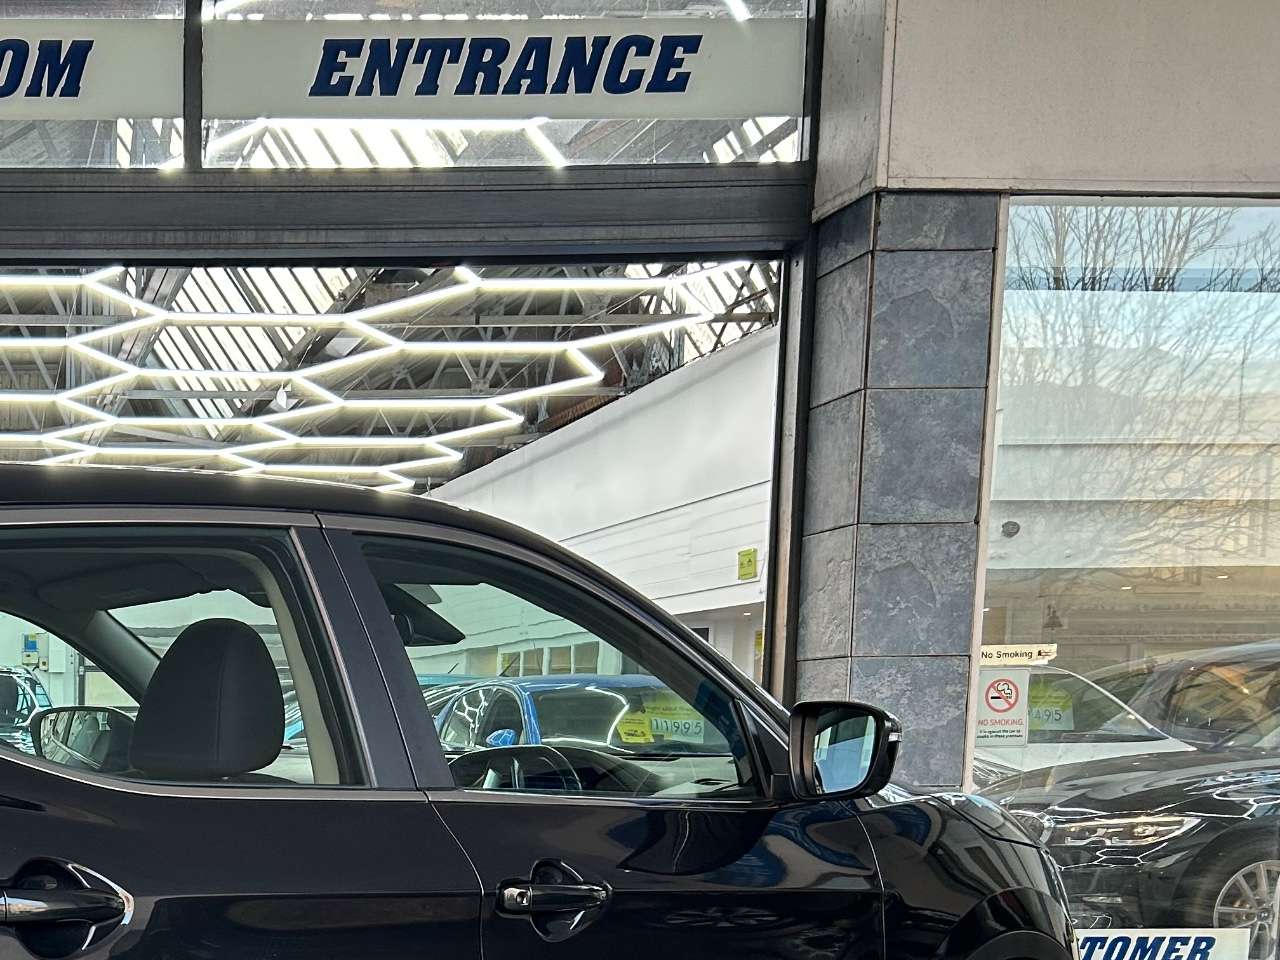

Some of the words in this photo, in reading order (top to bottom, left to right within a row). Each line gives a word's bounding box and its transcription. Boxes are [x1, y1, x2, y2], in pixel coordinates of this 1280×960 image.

[308, 34, 703, 97] ENTRANCE
[981, 651, 993, 659] No
[996, 650, 1033, 660] Smoking
[653, 718, 703, 736] 11995
[977, 719, 989, 727] NO
